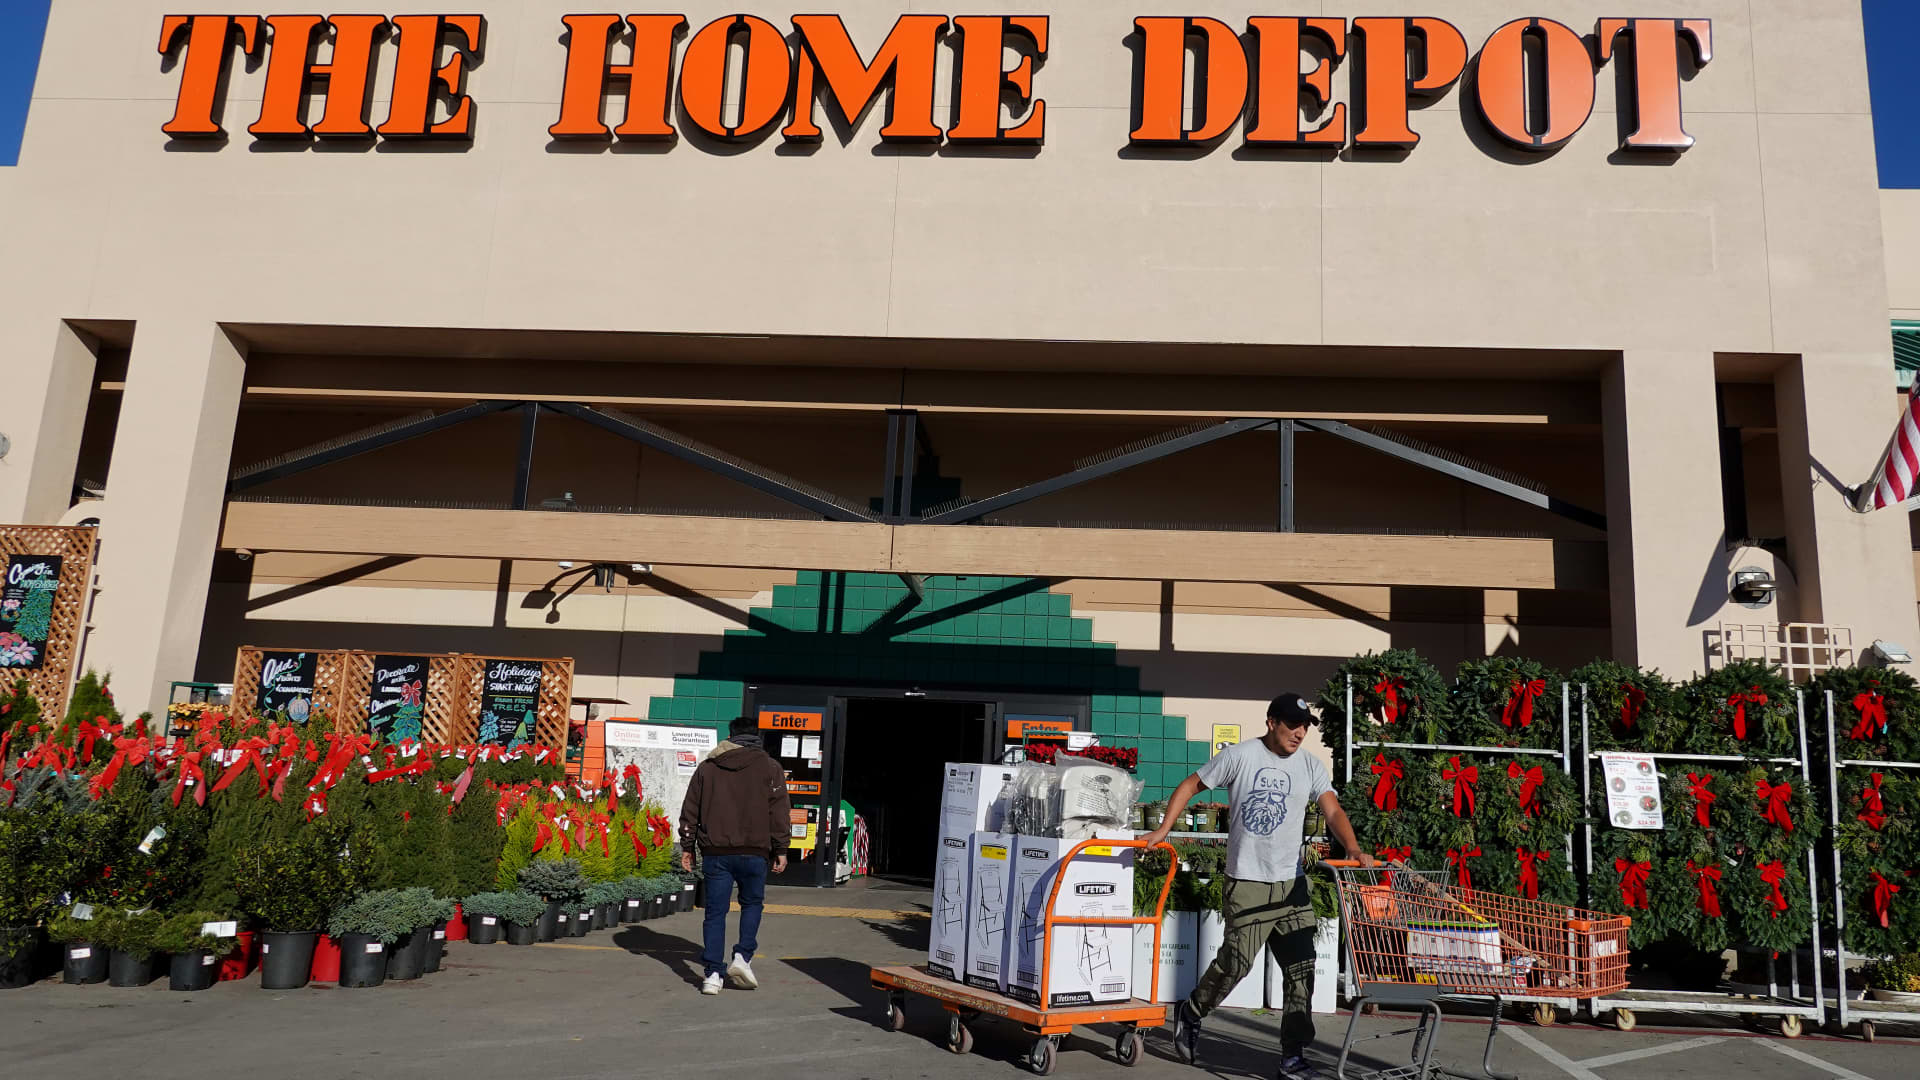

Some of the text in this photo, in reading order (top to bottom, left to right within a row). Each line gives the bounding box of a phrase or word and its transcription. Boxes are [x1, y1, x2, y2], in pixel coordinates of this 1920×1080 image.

[159, 13, 1713, 151] THE HOME DEPOT
[263, 658, 294, 687] Add
[376, 663, 419, 683] Decorate
[489, 663, 542, 684] Holidays
[489, 683, 513, 691] START
[493, 703, 527, 712] TREES
[772, 714, 808, 728] Enter
[1022, 723, 1059, 736] Enter
[671, 736, 710, 744] Guaranteed
[1260, 777, 1285, 790] SURF
[1025, 850, 1048, 858] LIFETIME
[1079, 885, 1112, 894] LIFETIME
[1056, 994, 1089, 1004] lifetime.com
